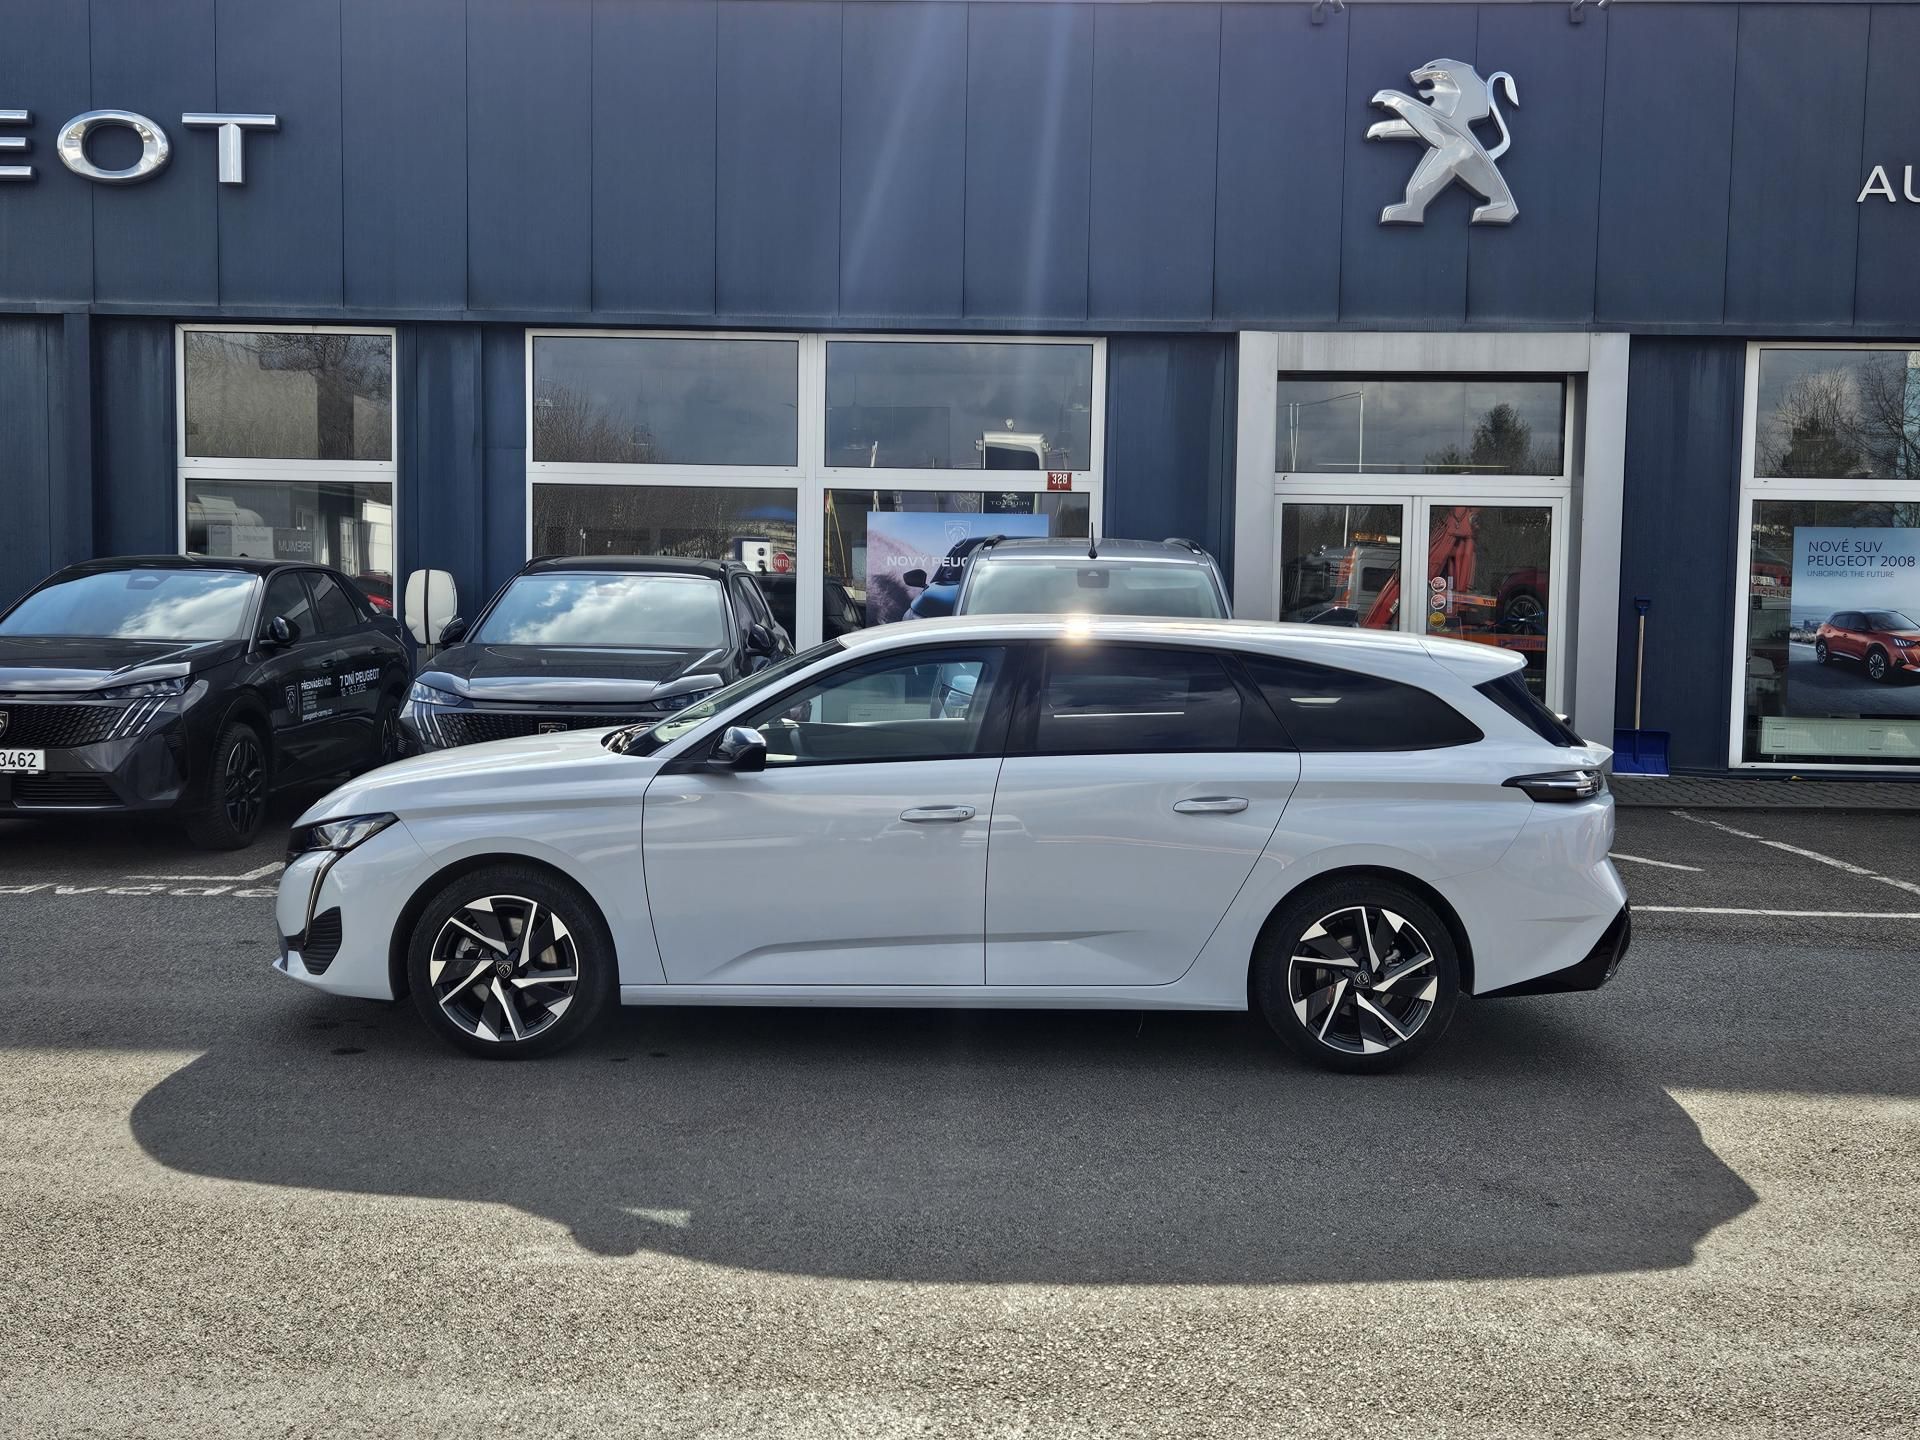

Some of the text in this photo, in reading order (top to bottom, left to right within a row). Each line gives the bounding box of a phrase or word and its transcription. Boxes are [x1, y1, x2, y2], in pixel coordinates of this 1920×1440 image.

[1052, 473, 1068, 485] 328
[1808, 538, 1883, 553] NOVÉ SUV
[887, 552, 928, 567] NOVÝ
[1807, 555, 1916, 568] PEUGEOT 2008
[355, 668, 380, 684] PEUGEOT
[0, 751, 37, 768] 3462
